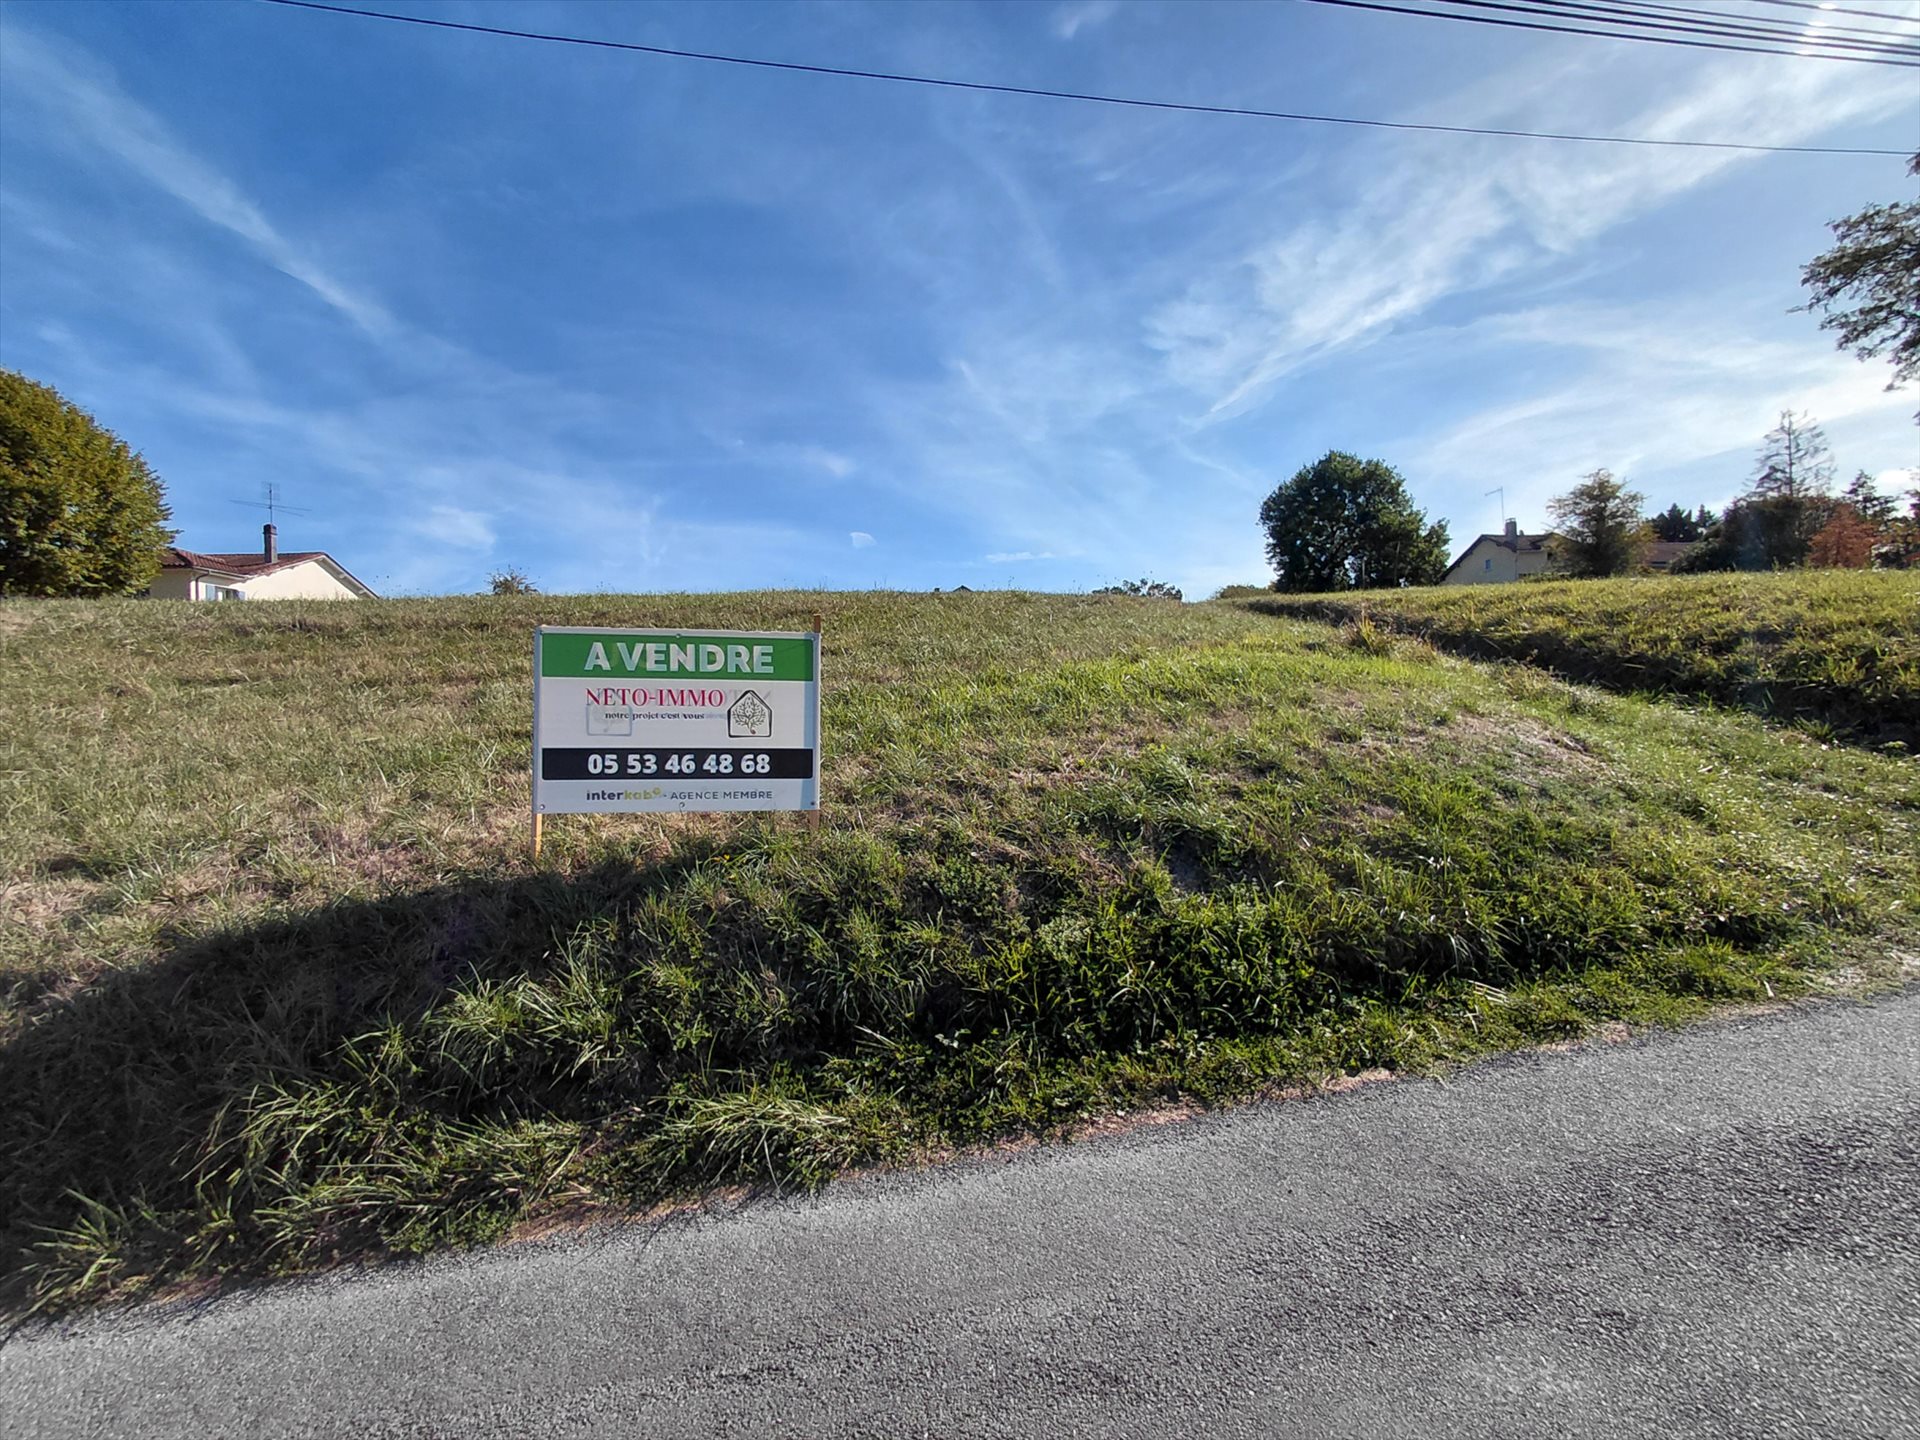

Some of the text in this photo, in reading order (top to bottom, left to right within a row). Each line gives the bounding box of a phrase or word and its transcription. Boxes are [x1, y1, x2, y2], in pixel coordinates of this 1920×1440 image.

[584, 641, 774, 673] A VENDRE
[585, 687, 724, 707] NETO-IMMO
[605, 712, 629, 720] notre
[632, 712, 659, 721] projet
[587, 753, 771, 774] 05 53 46 48 68
[670, 790, 719, 800] AGENCE
[722, 790, 773, 799] MEMBRE
